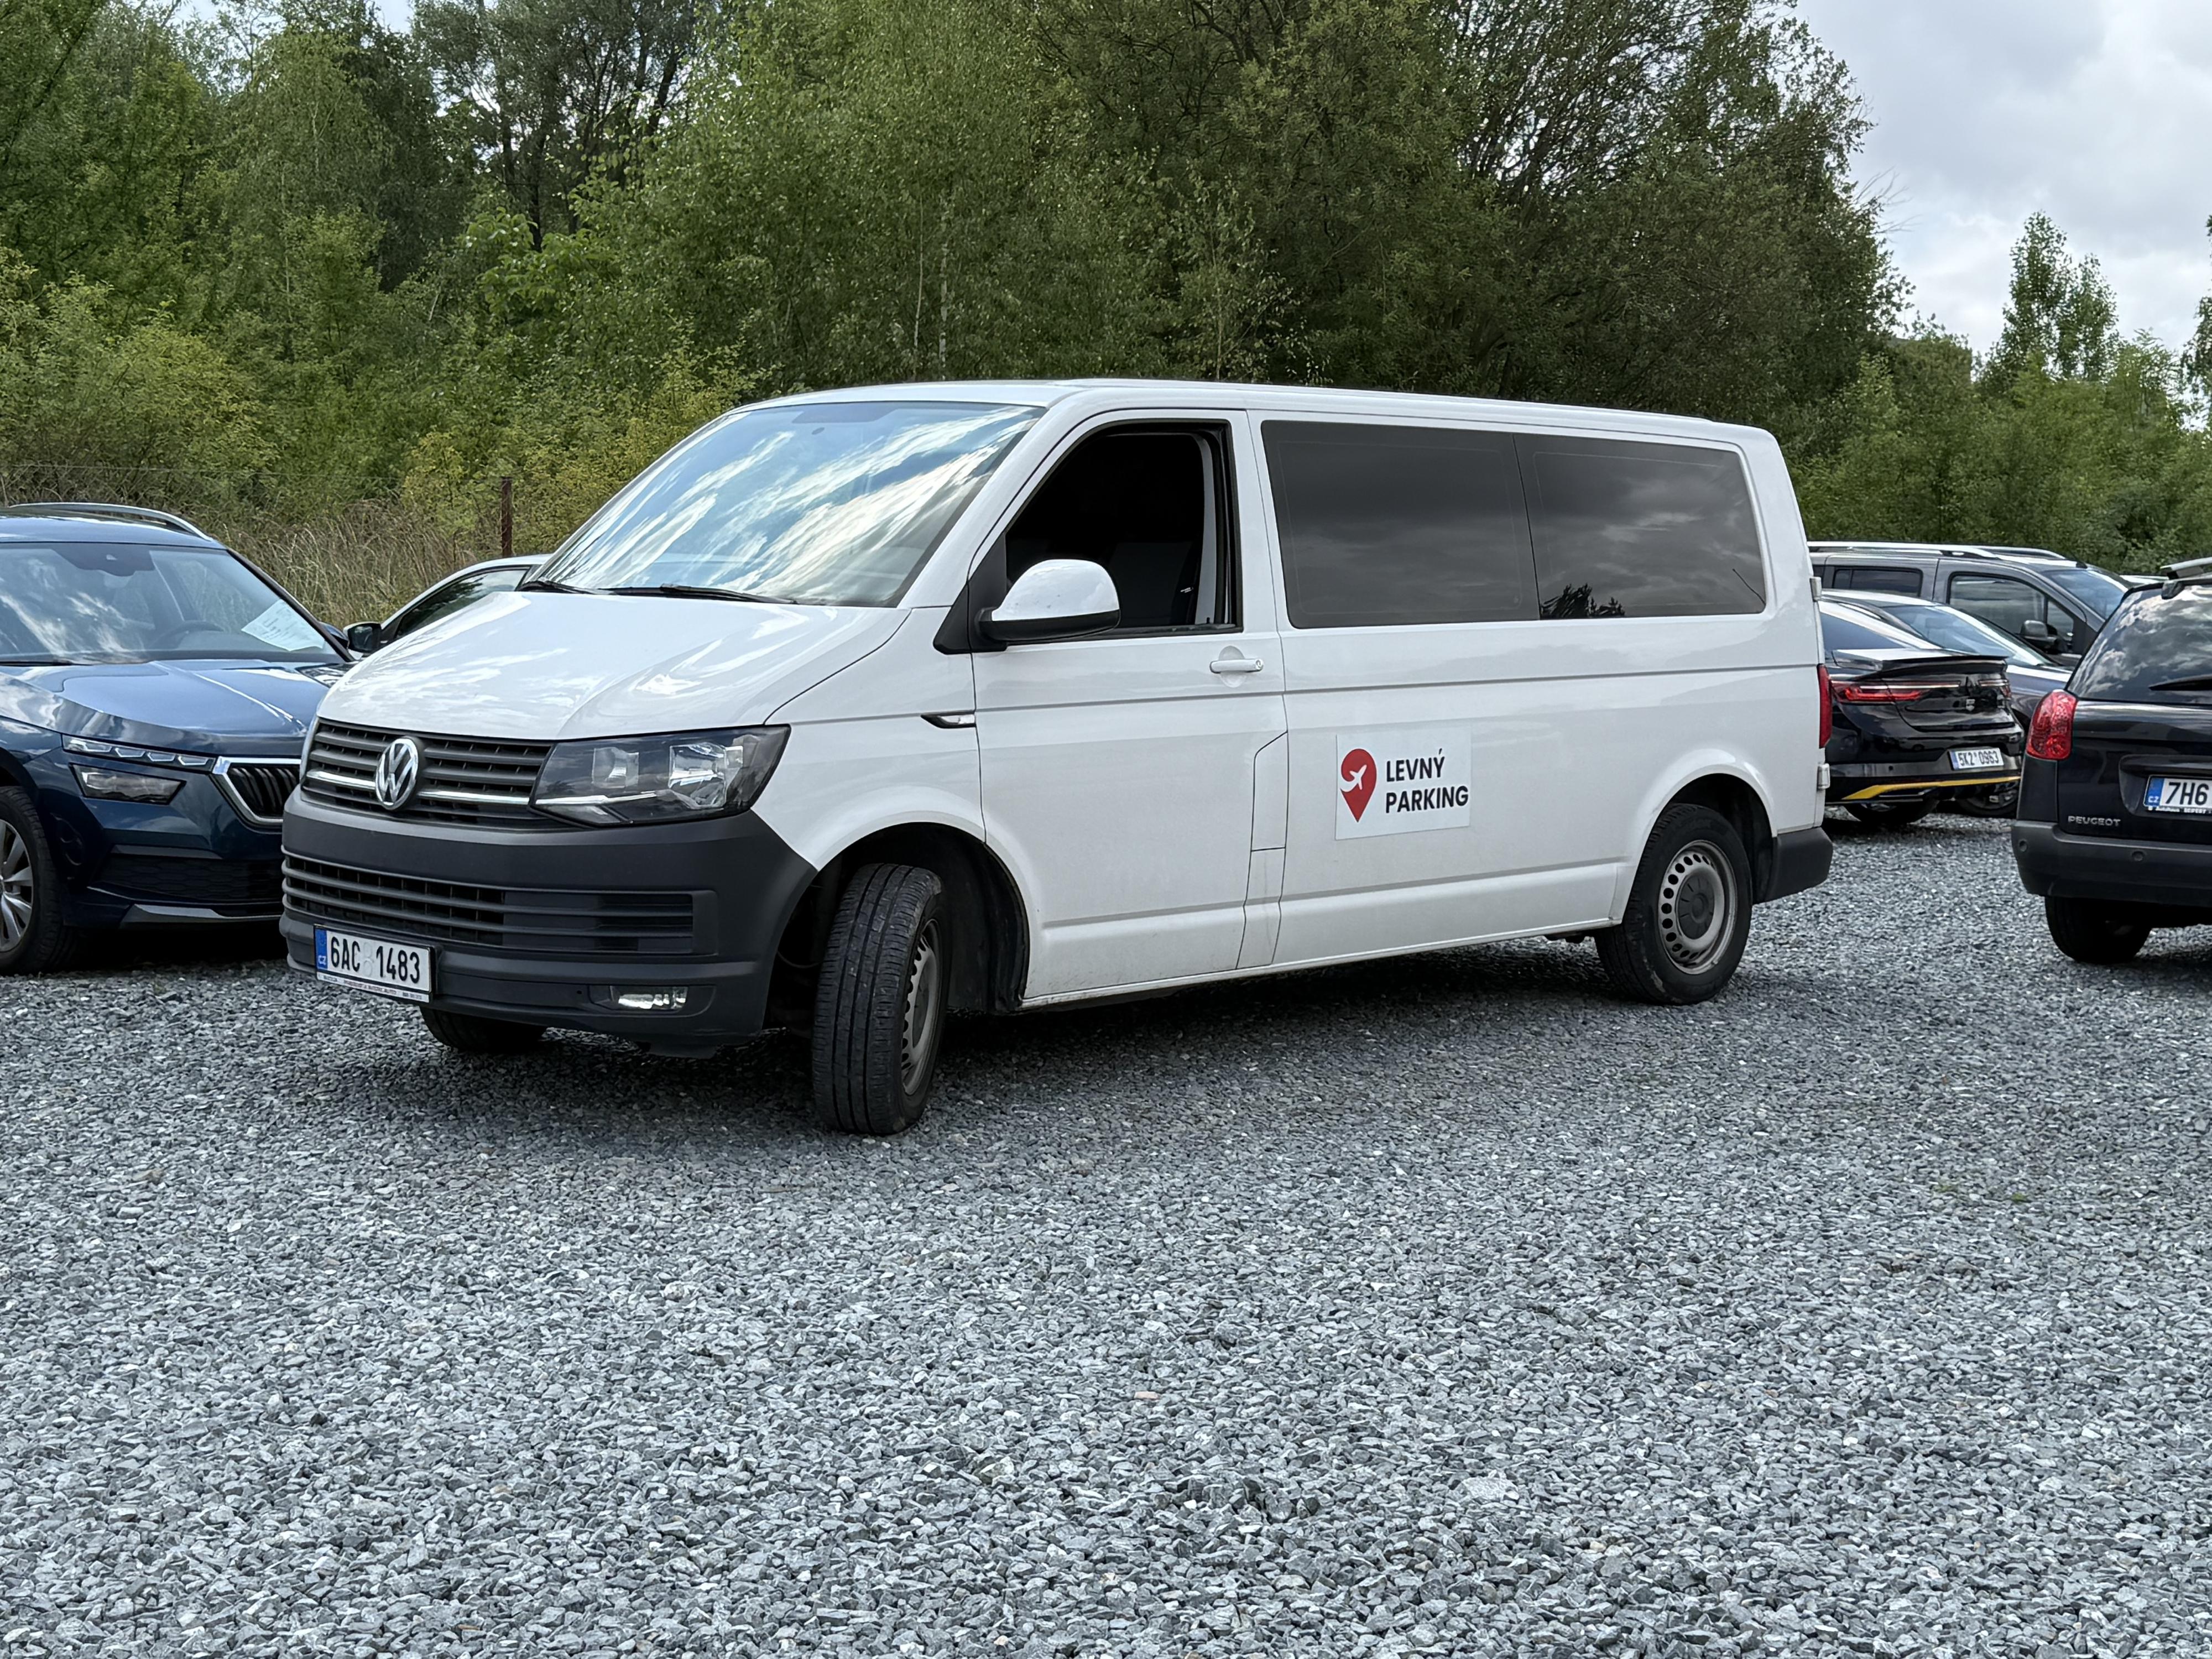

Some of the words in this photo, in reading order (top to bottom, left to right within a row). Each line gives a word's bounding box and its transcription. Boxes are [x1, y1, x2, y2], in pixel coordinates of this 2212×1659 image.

[1386, 748, 1445, 782] LEVNÝ
[1385, 785, 1469, 813] PARKING
[2165, 781, 2209, 805] 7H6
[2068, 815, 2121, 827] PEUGEOT
[331, 936, 361, 972] 6AC
[376, 946, 420, 984] 1483
